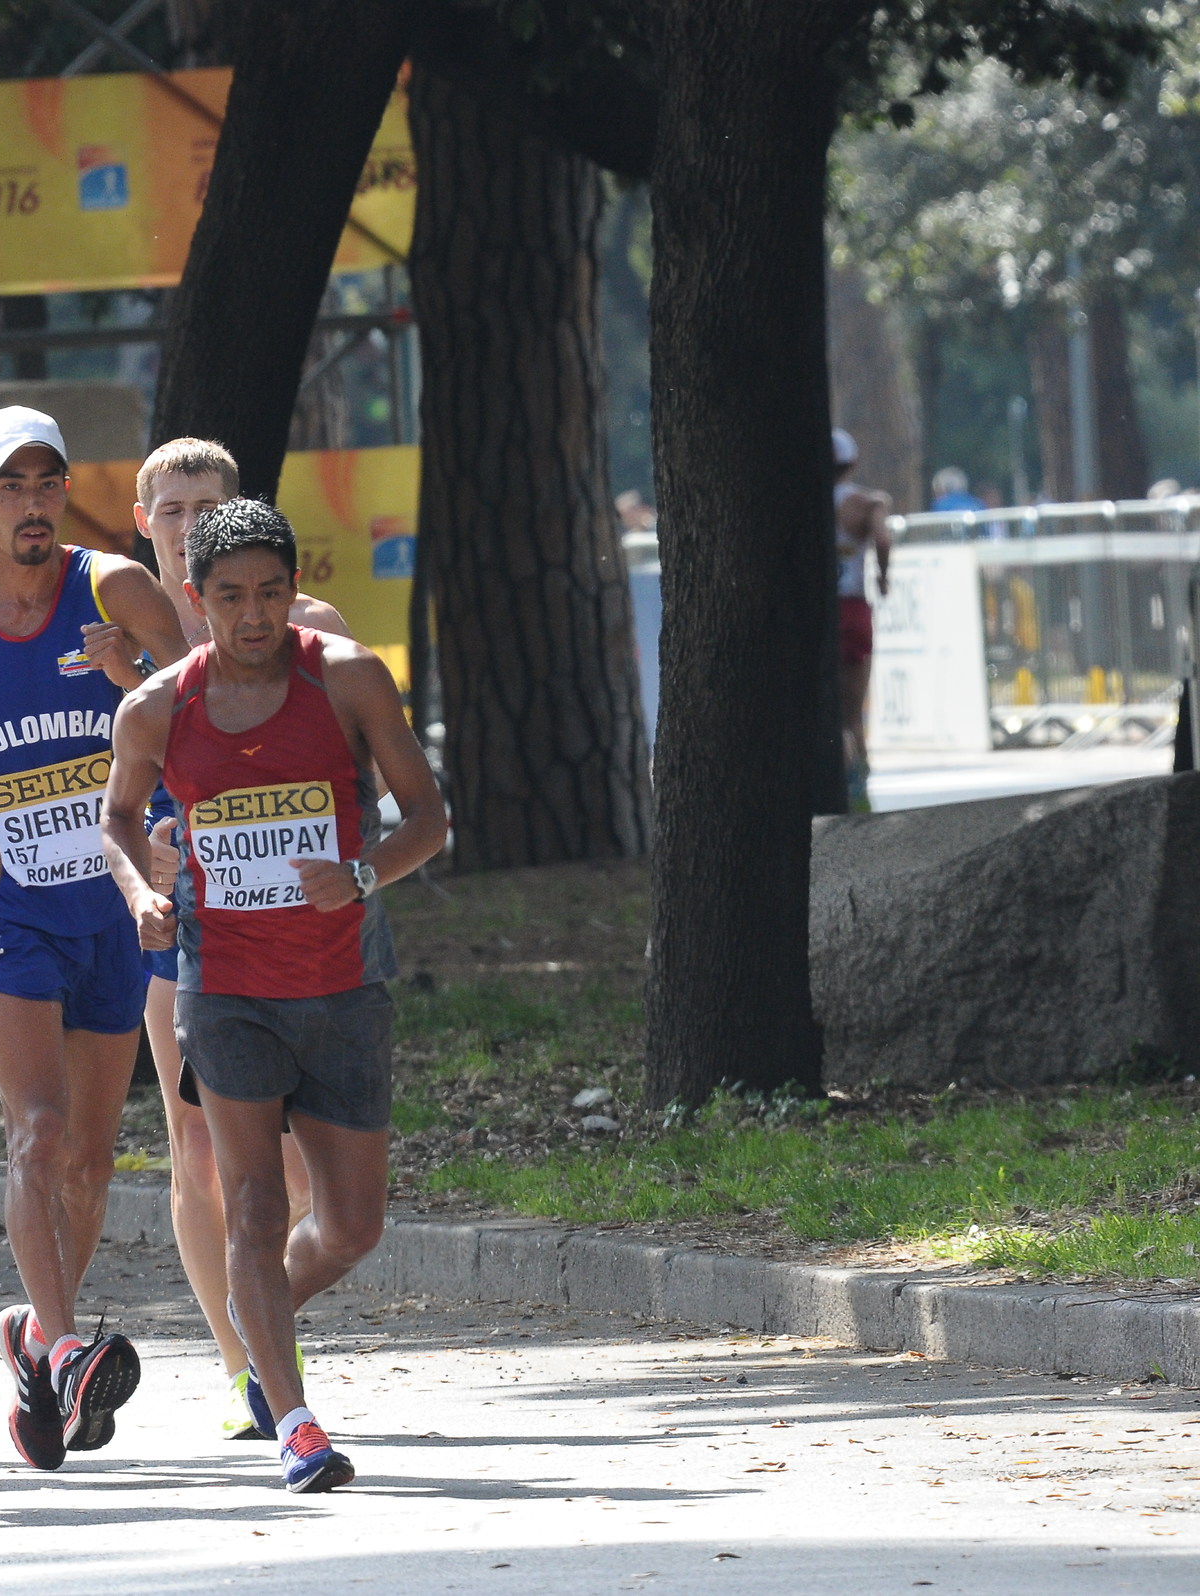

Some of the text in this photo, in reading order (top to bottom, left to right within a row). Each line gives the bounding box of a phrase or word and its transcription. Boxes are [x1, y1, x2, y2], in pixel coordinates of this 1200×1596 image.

[195, 785, 329, 825] SEIKO
[4, 844, 39, 865] 157
[199, 822, 329, 863] SAQUIPAY
[27, 854, 109, 883] ROME 201
[206, 866, 242, 887] 170
[223, 885, 304, 907] ROME 20
